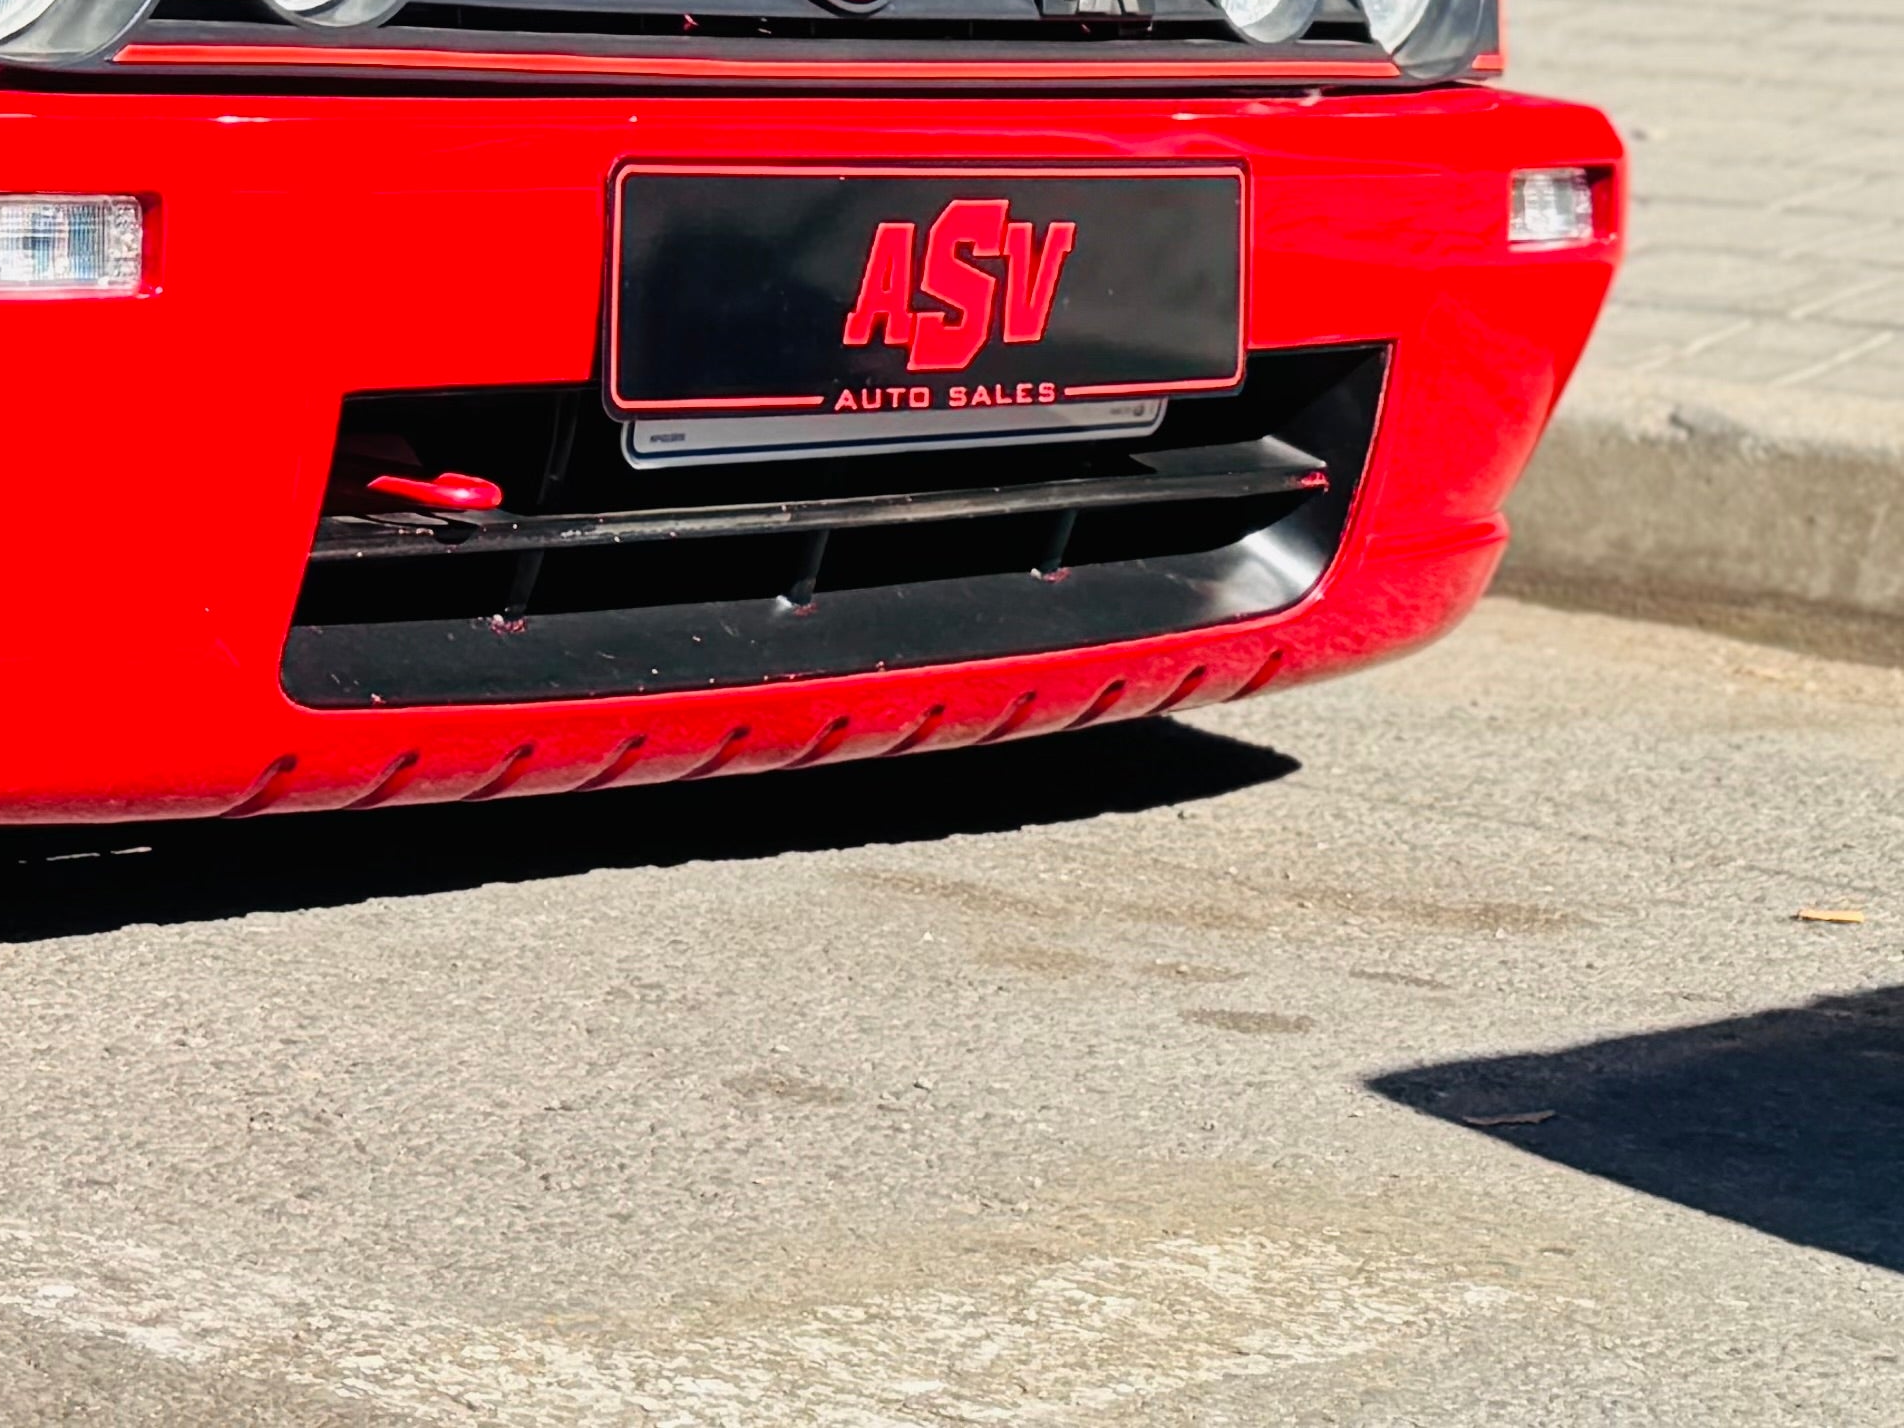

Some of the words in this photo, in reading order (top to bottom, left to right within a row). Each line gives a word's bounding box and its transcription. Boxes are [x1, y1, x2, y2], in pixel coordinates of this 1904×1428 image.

[842, 197, 1077, 372] ASV
[833, 387, 931, 412] AUTO
[947, 380, 1058, 408] SALES
